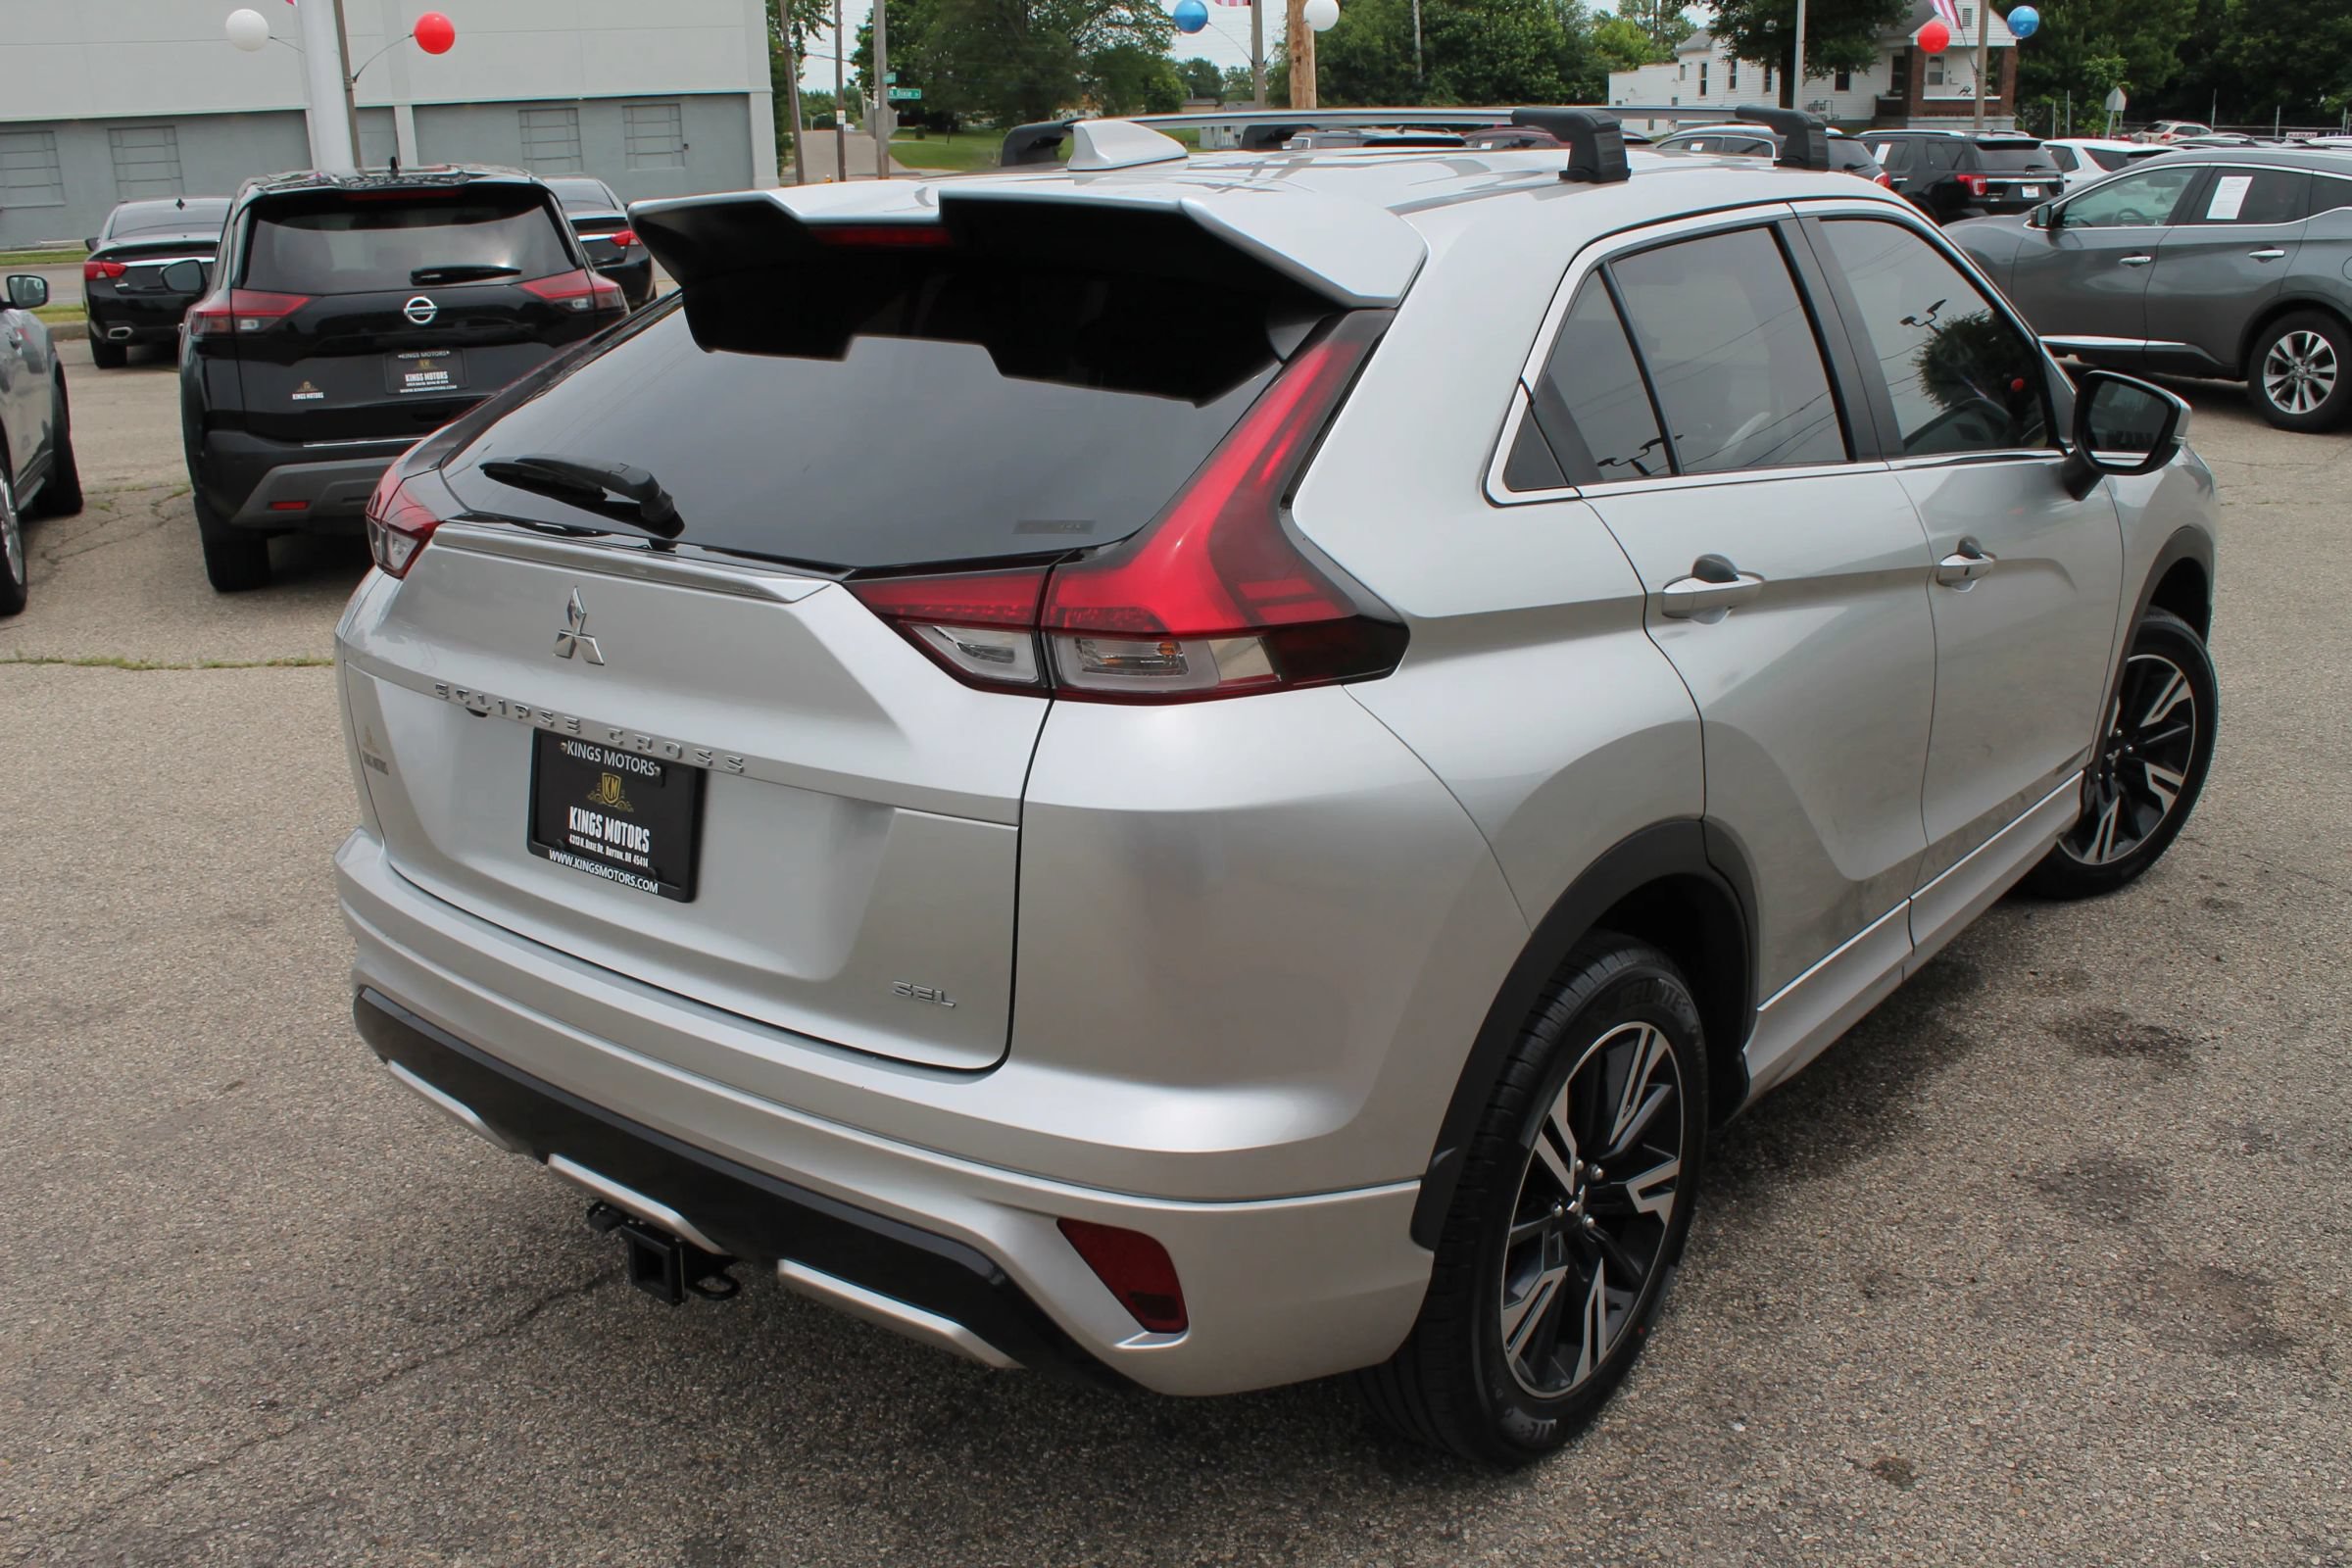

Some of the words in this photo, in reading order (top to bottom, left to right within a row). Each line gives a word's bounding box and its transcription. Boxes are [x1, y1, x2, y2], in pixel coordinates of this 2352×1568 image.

[405, 373, 424, 382] KINGS
[424, 370, 449, 381] MOTORS
[434, 682, 581, 734] ECLIPSE
[607, 726, 746, 774] CROSS
[566, 740, 602, 762] KINGS
[604, 752, 656, 777] MOTORS
[604, 775, 618, 799] KM
[569, 806, 603, 839] KINGS
[605, 816, 651, 854] MOTORS
[548, 849, 659, 895] WWW.KINGSMOTORS.COM
[633, 855, 649, 868] 45414
[892, 980, 957, 1008] SEL
